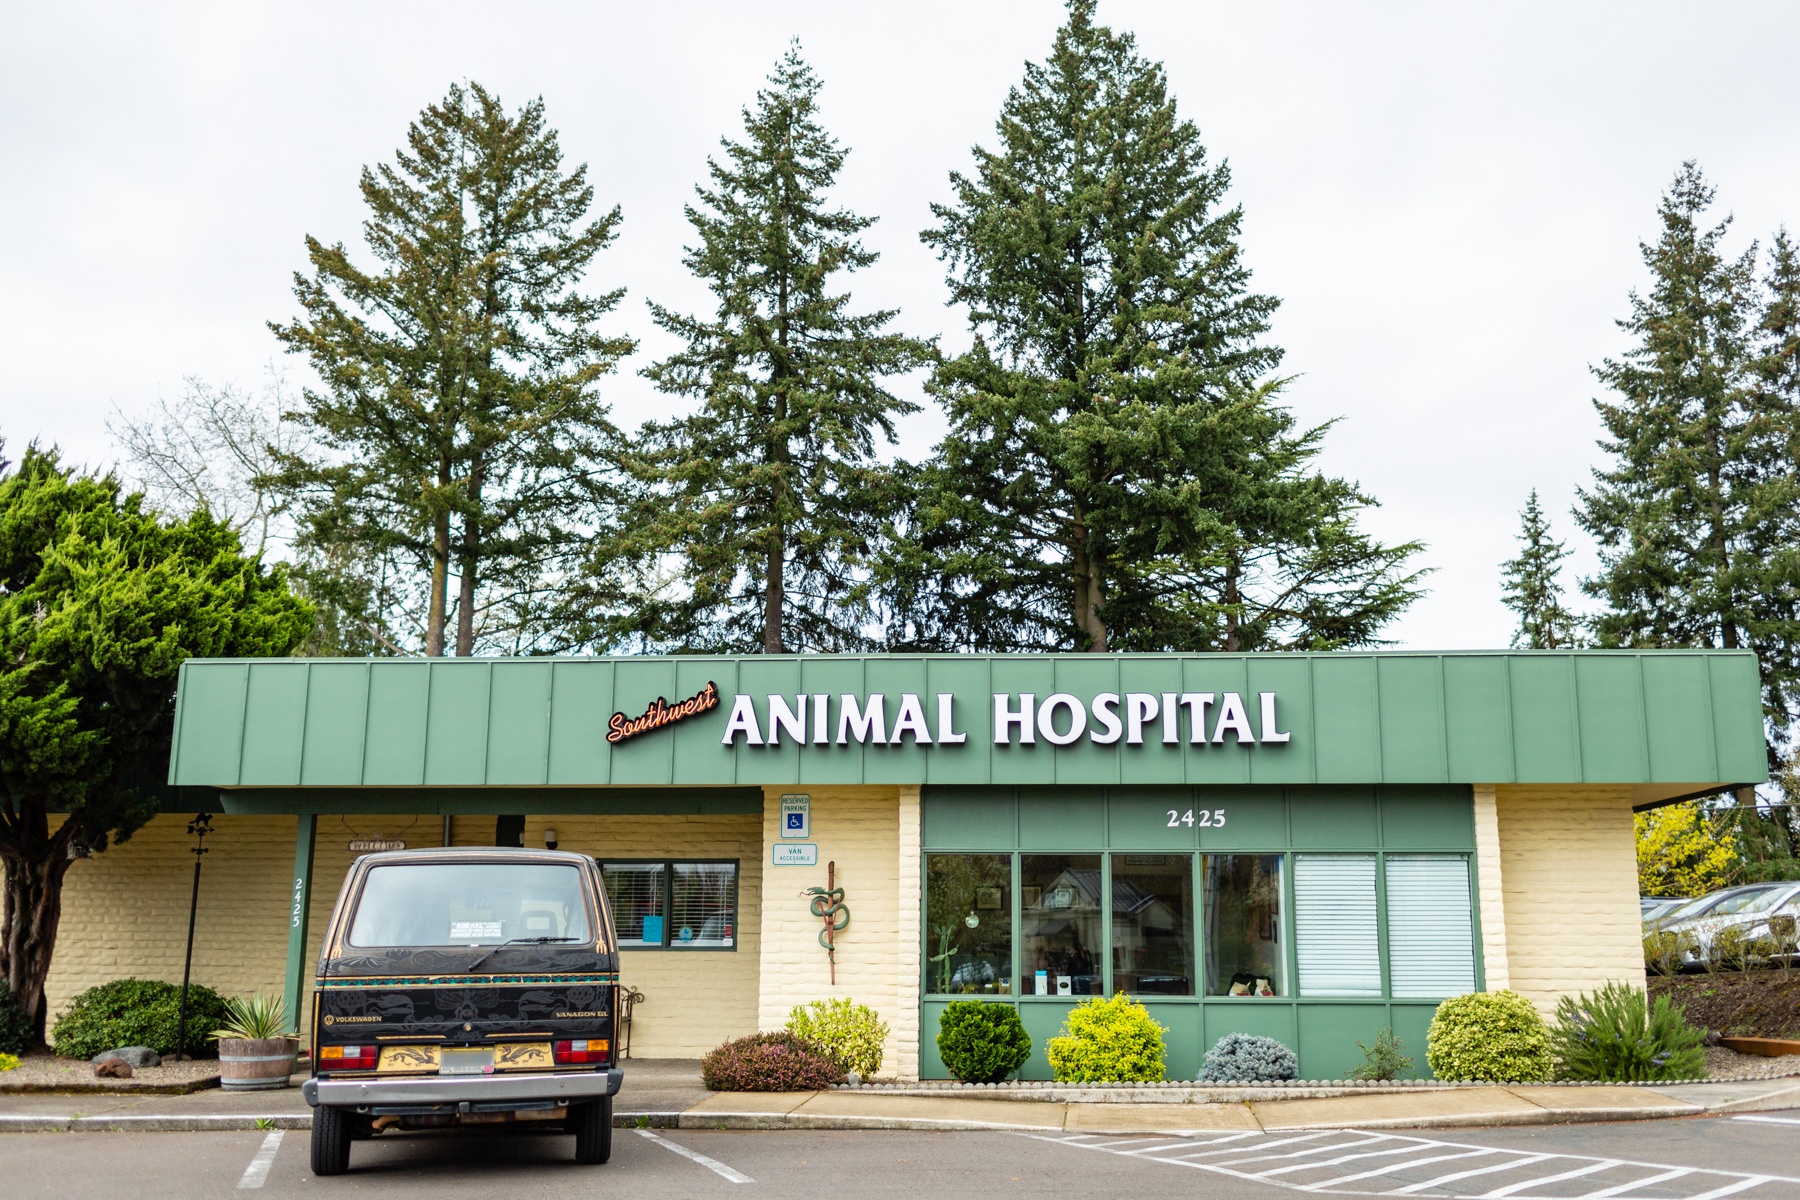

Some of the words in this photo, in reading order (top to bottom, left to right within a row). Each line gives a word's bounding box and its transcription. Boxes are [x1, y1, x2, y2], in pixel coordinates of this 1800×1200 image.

[606, 681, 718, 744] Southwest
[720, 693, 967, 745] ANIMAL
[993, 691, 1291, 745] HOSPITAL
[1166, 809, 1226, 827] 2425
[352, 841, 402, 850] WELCOME
[292, 878, 303, 928] 2425
